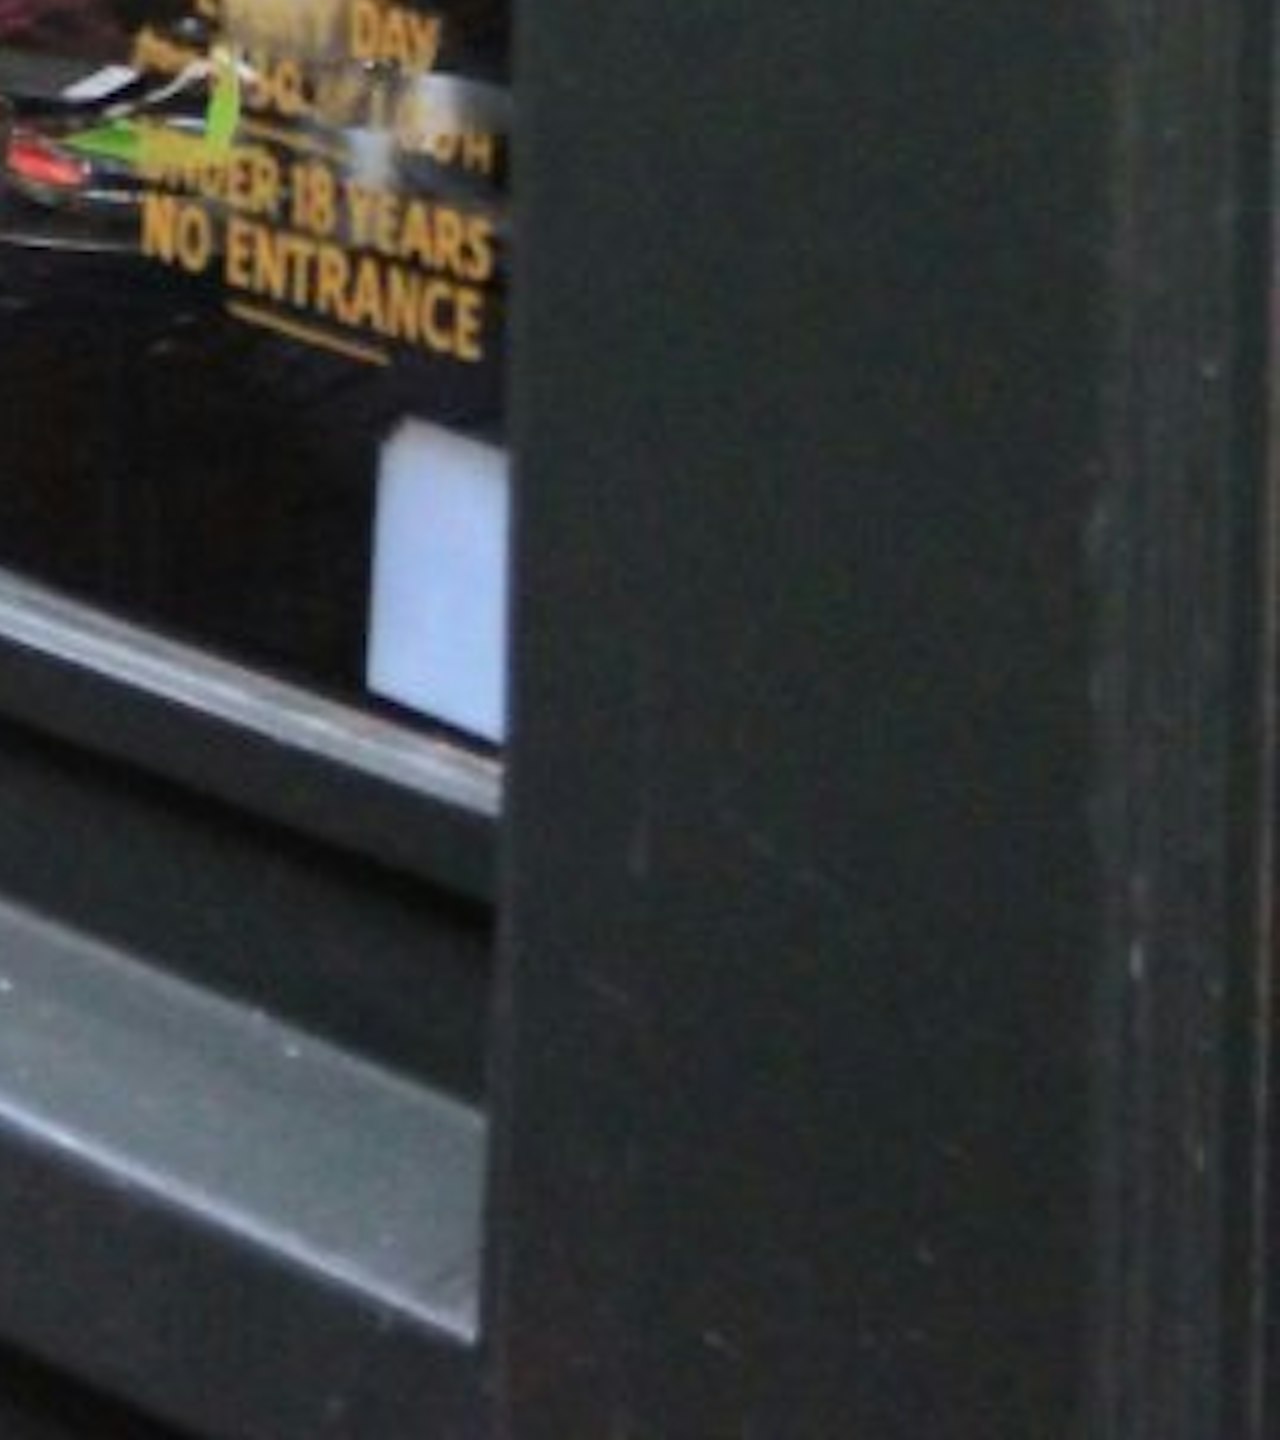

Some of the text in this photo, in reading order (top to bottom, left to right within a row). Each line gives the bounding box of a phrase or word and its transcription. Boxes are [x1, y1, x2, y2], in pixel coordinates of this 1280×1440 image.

[140, 196, 485, 365] NO ENTRANCE
[291, 164, 336, 236] 18
[347, 182, 494, 282] YEARS
